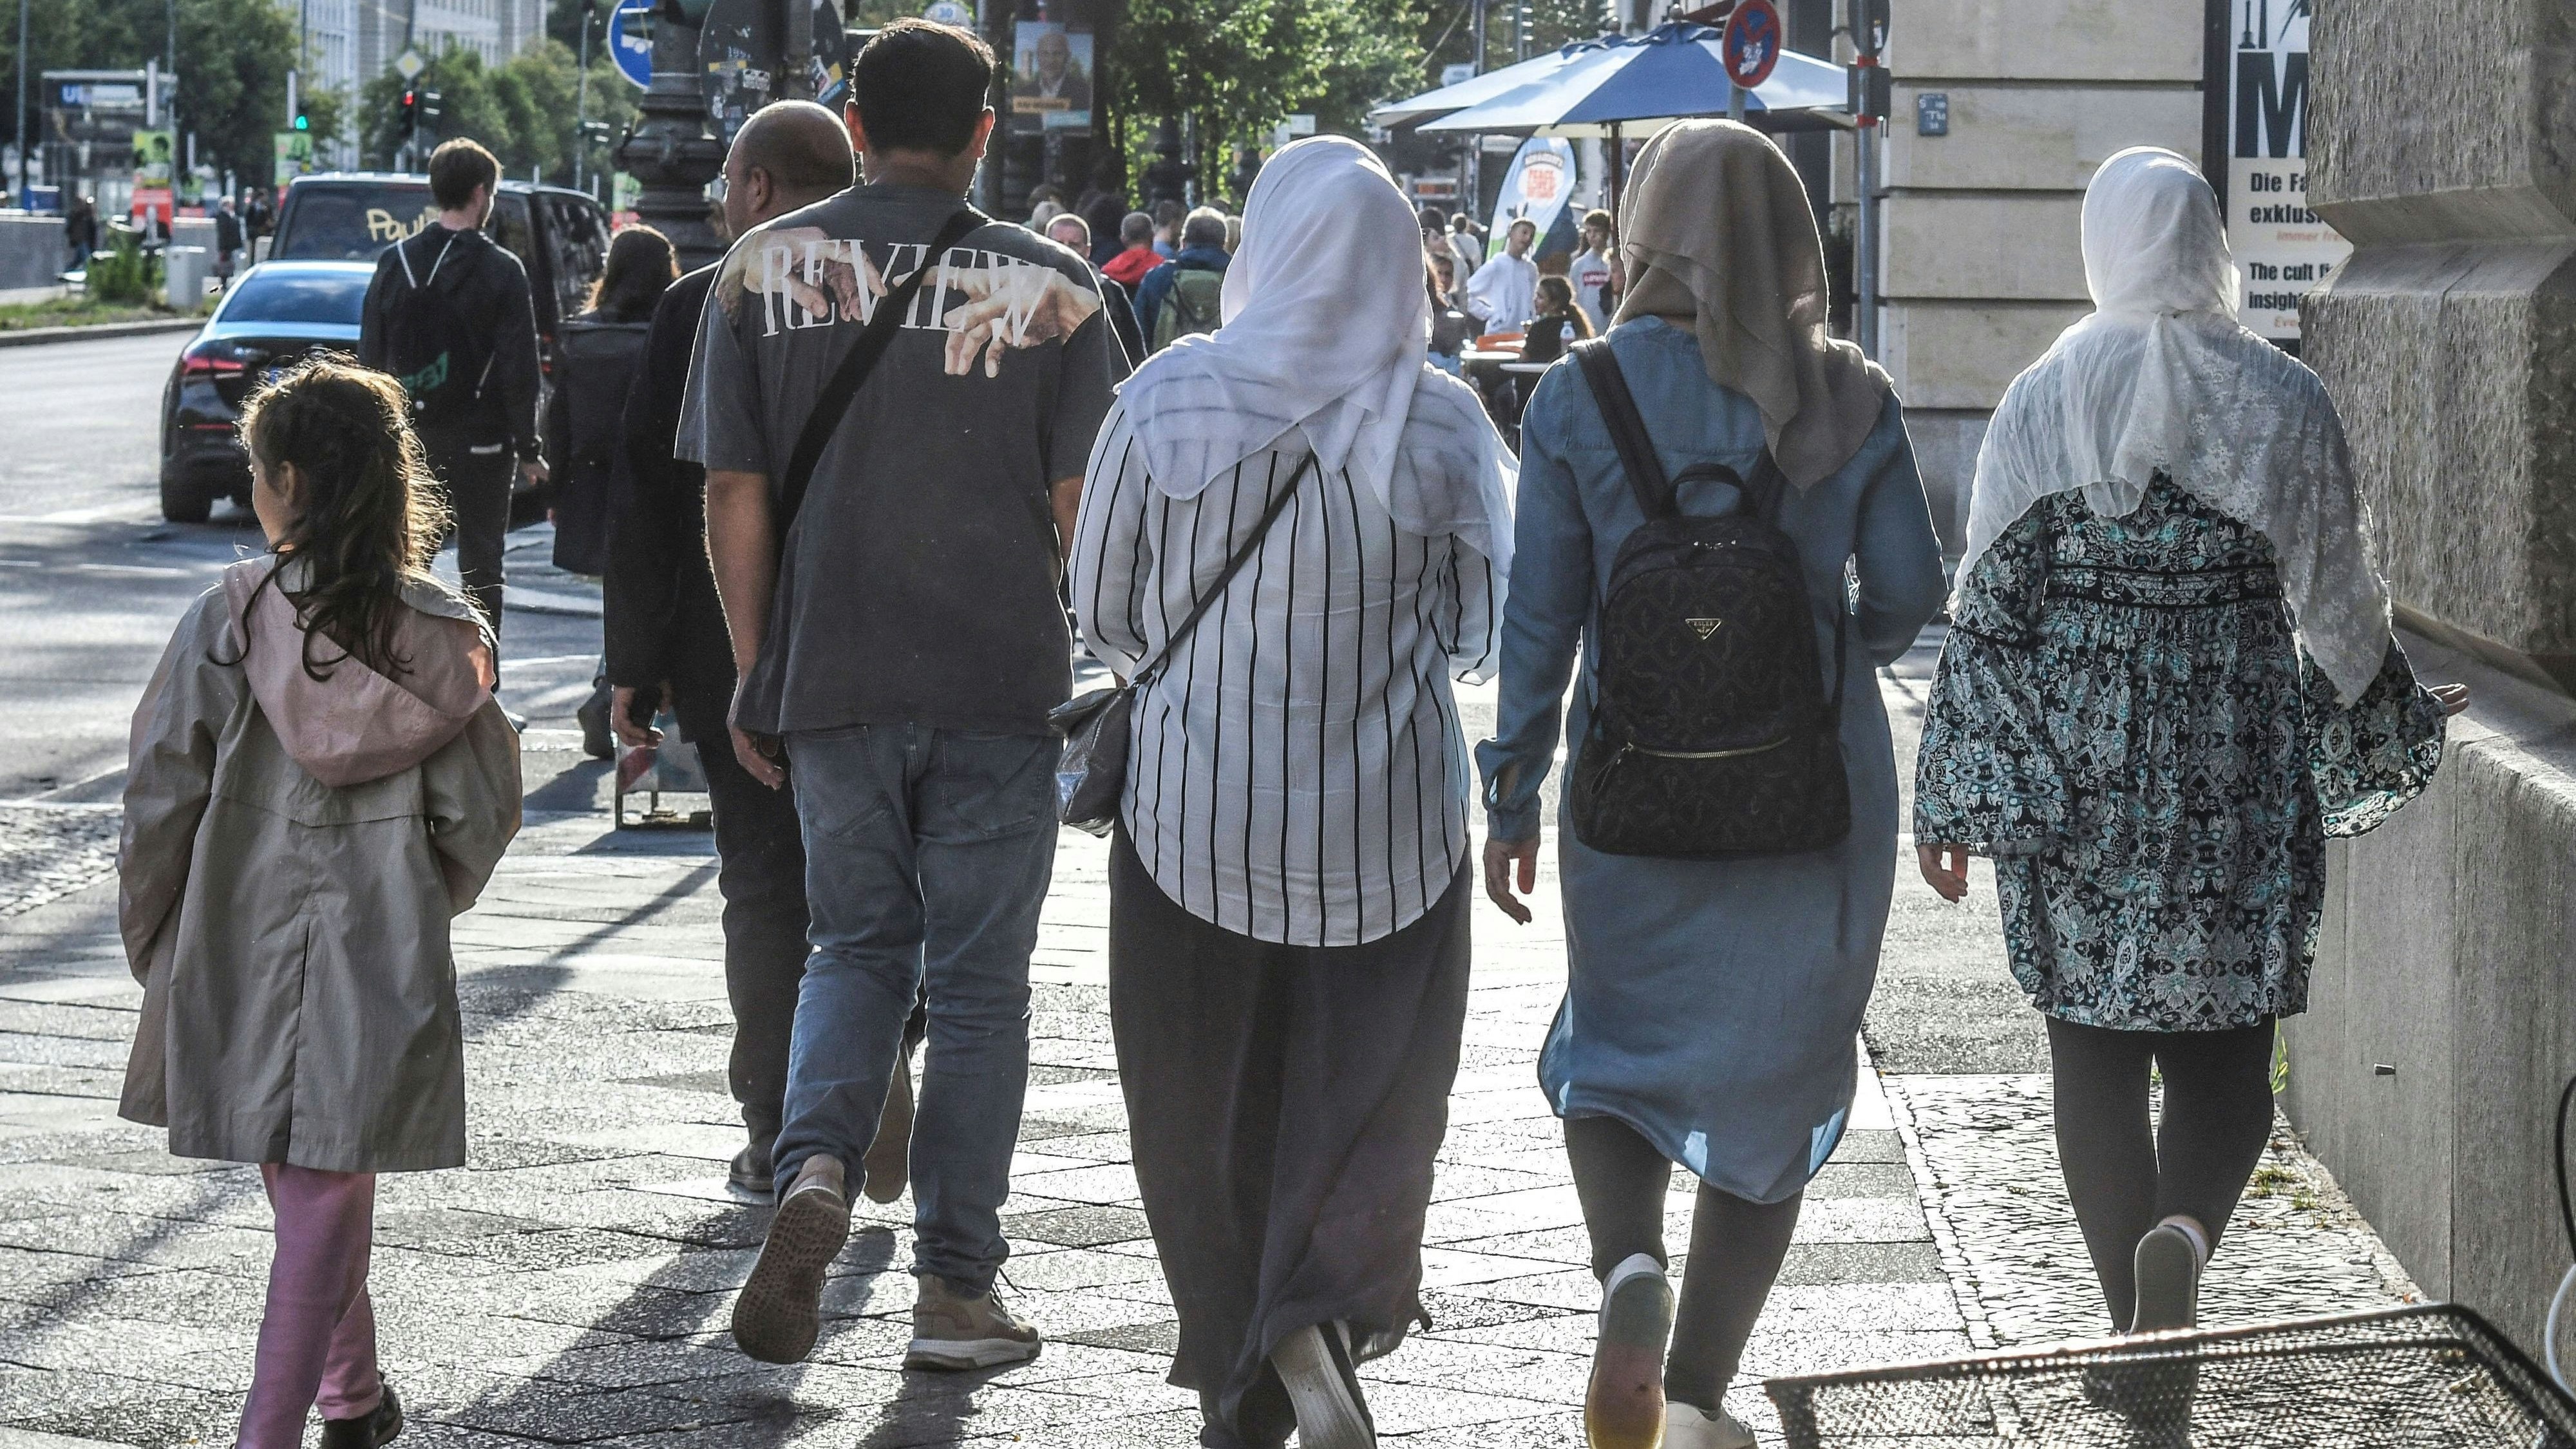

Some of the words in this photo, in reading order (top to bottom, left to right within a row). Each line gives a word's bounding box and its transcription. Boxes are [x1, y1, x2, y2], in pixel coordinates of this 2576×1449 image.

[2251, 173, 2282, 192] Die
[2249, 262, 2277, 281] The
[2283, 263, 2313, 281] cult
[762, 239, 1057, 348] REVIEW
[2249, 291, 2304, 310] insigh
